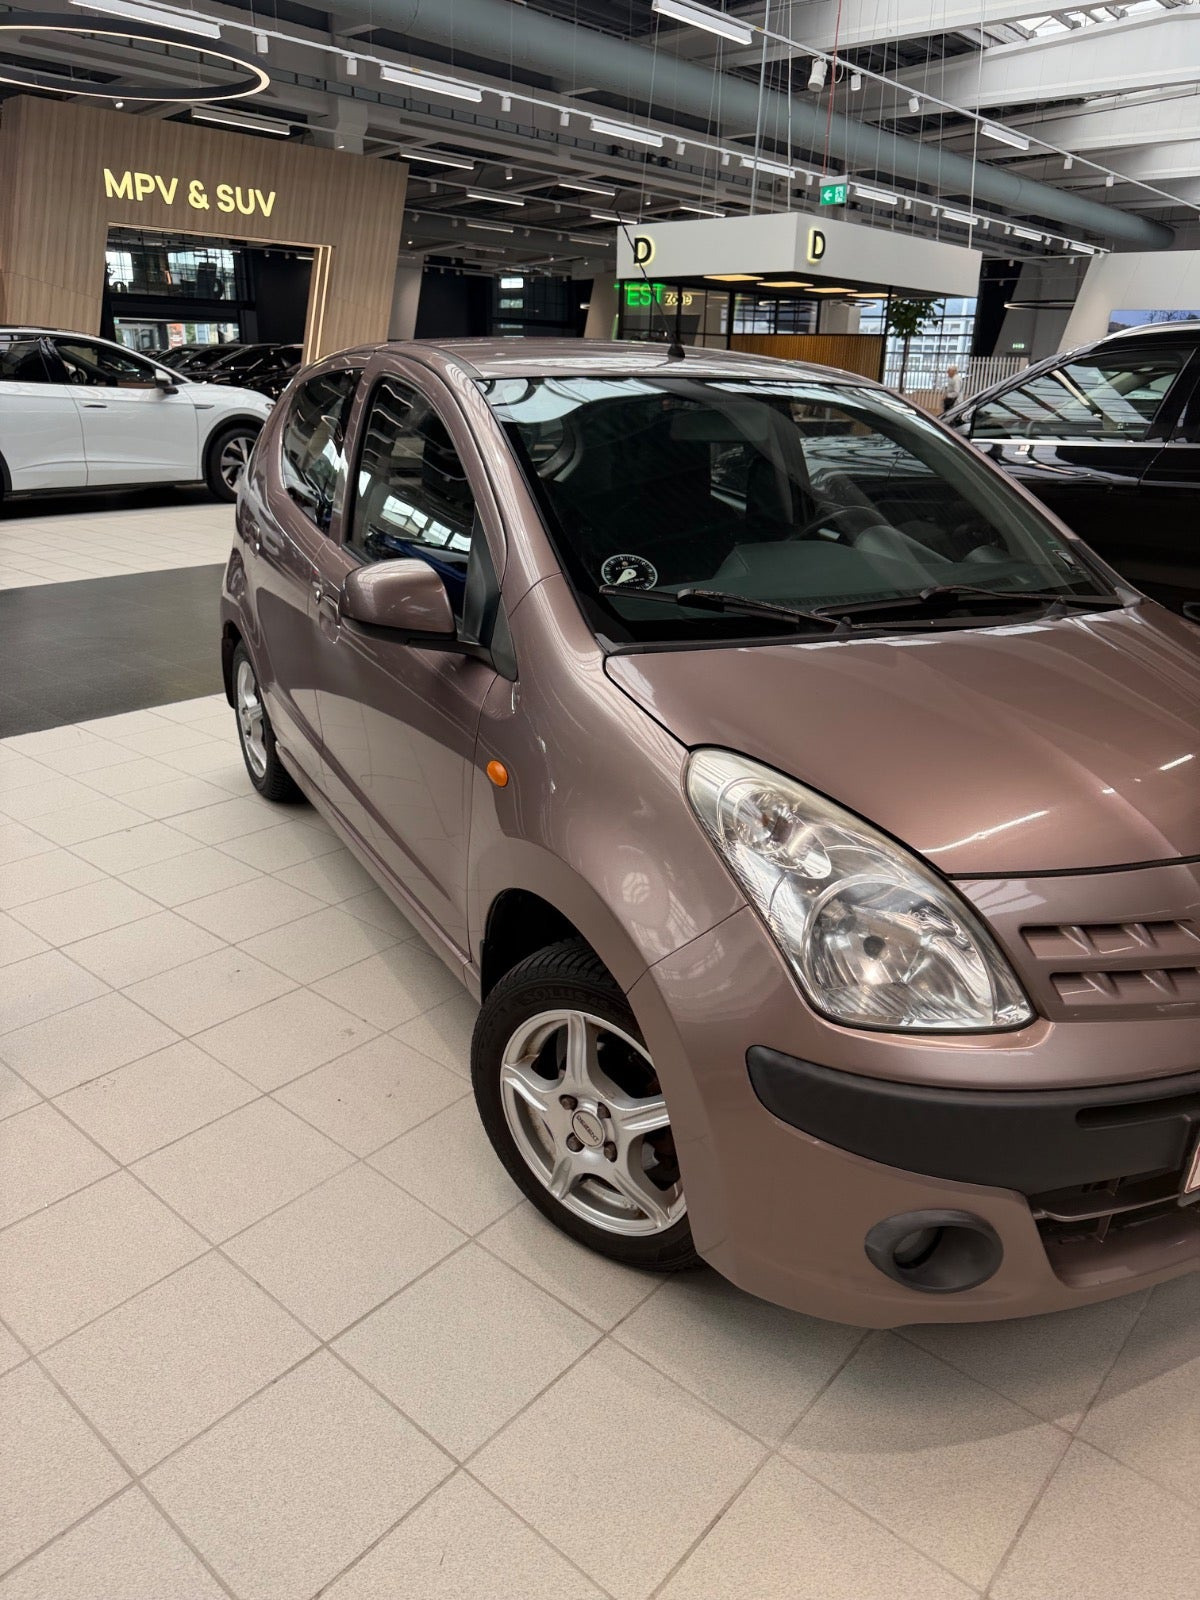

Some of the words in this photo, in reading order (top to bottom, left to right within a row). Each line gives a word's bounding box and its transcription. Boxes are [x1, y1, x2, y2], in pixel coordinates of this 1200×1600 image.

[103, 168, 179, 205] MPV
[188, 180, 210, 210] &
[216, 184, 276, 217] SUV
[633, 236, 653, 265] D
[811, 229, 826, 261] D
